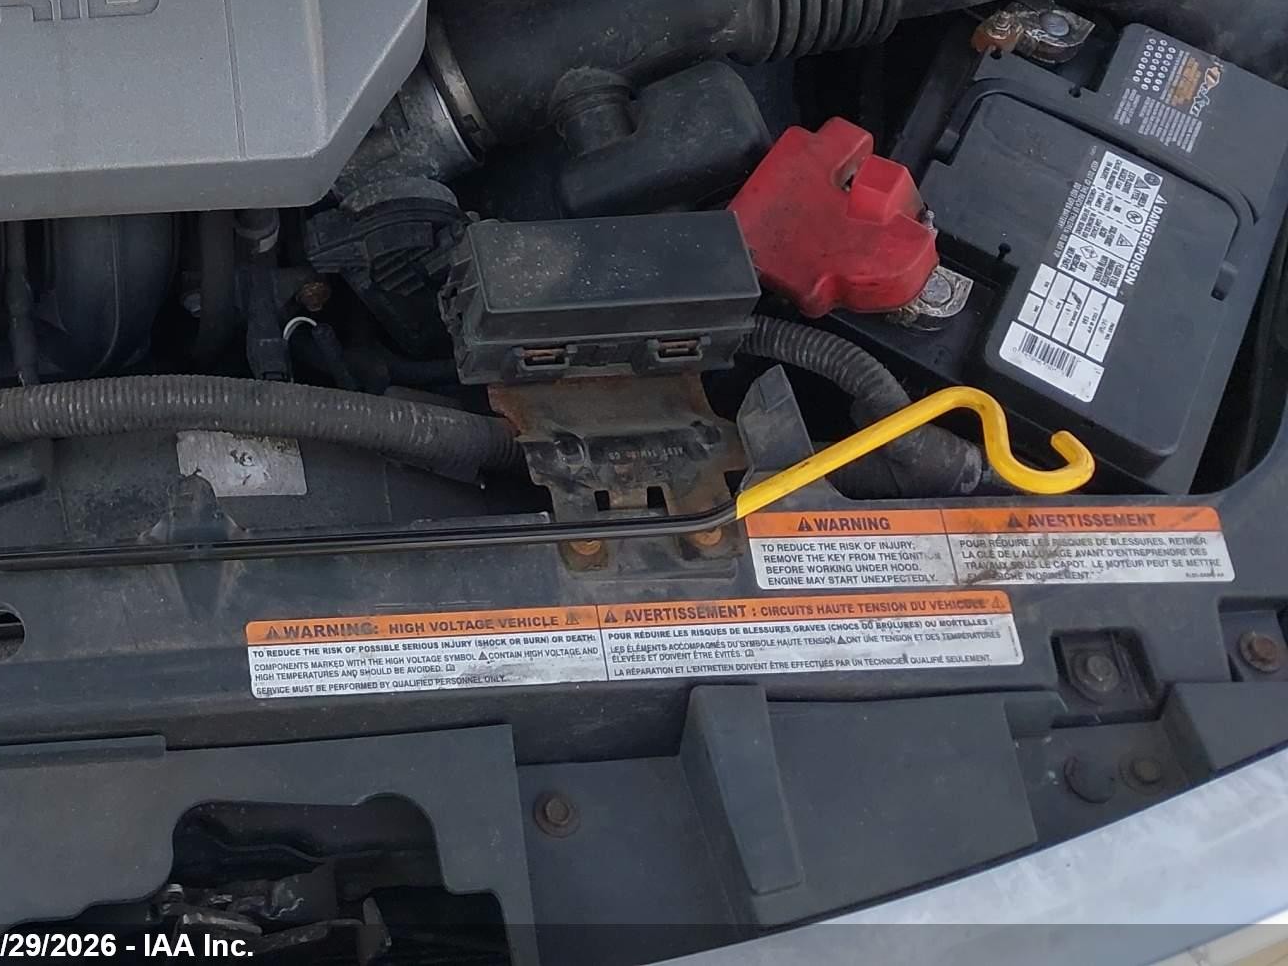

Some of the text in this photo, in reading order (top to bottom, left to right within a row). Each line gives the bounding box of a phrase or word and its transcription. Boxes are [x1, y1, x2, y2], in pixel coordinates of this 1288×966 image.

[1123, 204, 1163, 285] DANGER/POISON
[814, 516, 890, 531] WARNING
[1026, 513, 1156, 527] AVERTISSEMENT
[761, 544, 775, 554] TO
[776, 542, 815, 554] REDUCE
[818, 542, 836, 552] THE
[838, 541, 861, 552] RISK
[863, 540, 876, 551] OF
[763, 551, 896, 565] REMOVE THE KEY FROM THE
[765, 561, 921, 575] BEFORE WORKING UNDER HOOD.
[767, 576, 803, 587] ENGINE
[805, 575, 825, 586] MAY
[827, 574, 858, 585] START
[284, 616, 558, 638] WARNING: HIGH VOLTAGE VEHICLE
[253, 650, 264, 658] TO
[266, 648, 300, 657] REDUCE
[304, 647, 319, 655] THE
[322, 646, 341, 654] RISK
[345, 645, 355, 653] OF
[358, 643, 399, 652] POSSIBLE
[402, 641, 438, 650] SERIOUS
[441, 640, 471, 648] INJURY
[509, 637, 520, 645] OR
[551, 635, 563, 643] OR
[254, 661, 308, 671] COMPONENTS
[311, 659, 344, 668] MARKED
[346, 658, 366, 666] WITH
[368, 657, 381, 665] THE
[385, 656, 404, 664] HIGH
[406, 655, 440, 663] VOLTAGE
[444, 653, 476, 661] SYMBOL
[488, 650, 522, 659] CONTAIN
[524, 649, 543, 657] HIGH
[545, 648, 580, 656] VOLTAGE
[255, 673, 274, 681] HIGH
[277, 670, 338, 680] TEMPERATURES
[341, 669, 357, 677] AND
[359, 667, 392, 676] SHOULD
[394, 666, 404, 674] BE
[256, 686, 288, 694] SERVICE
[292, 684, 312, 692] MUST
[328, 681, 377, 690] PERFORMED
[392, 678, 433, 687] QUALIFIED
[435, 676, 482, 685] PERSONNEL
